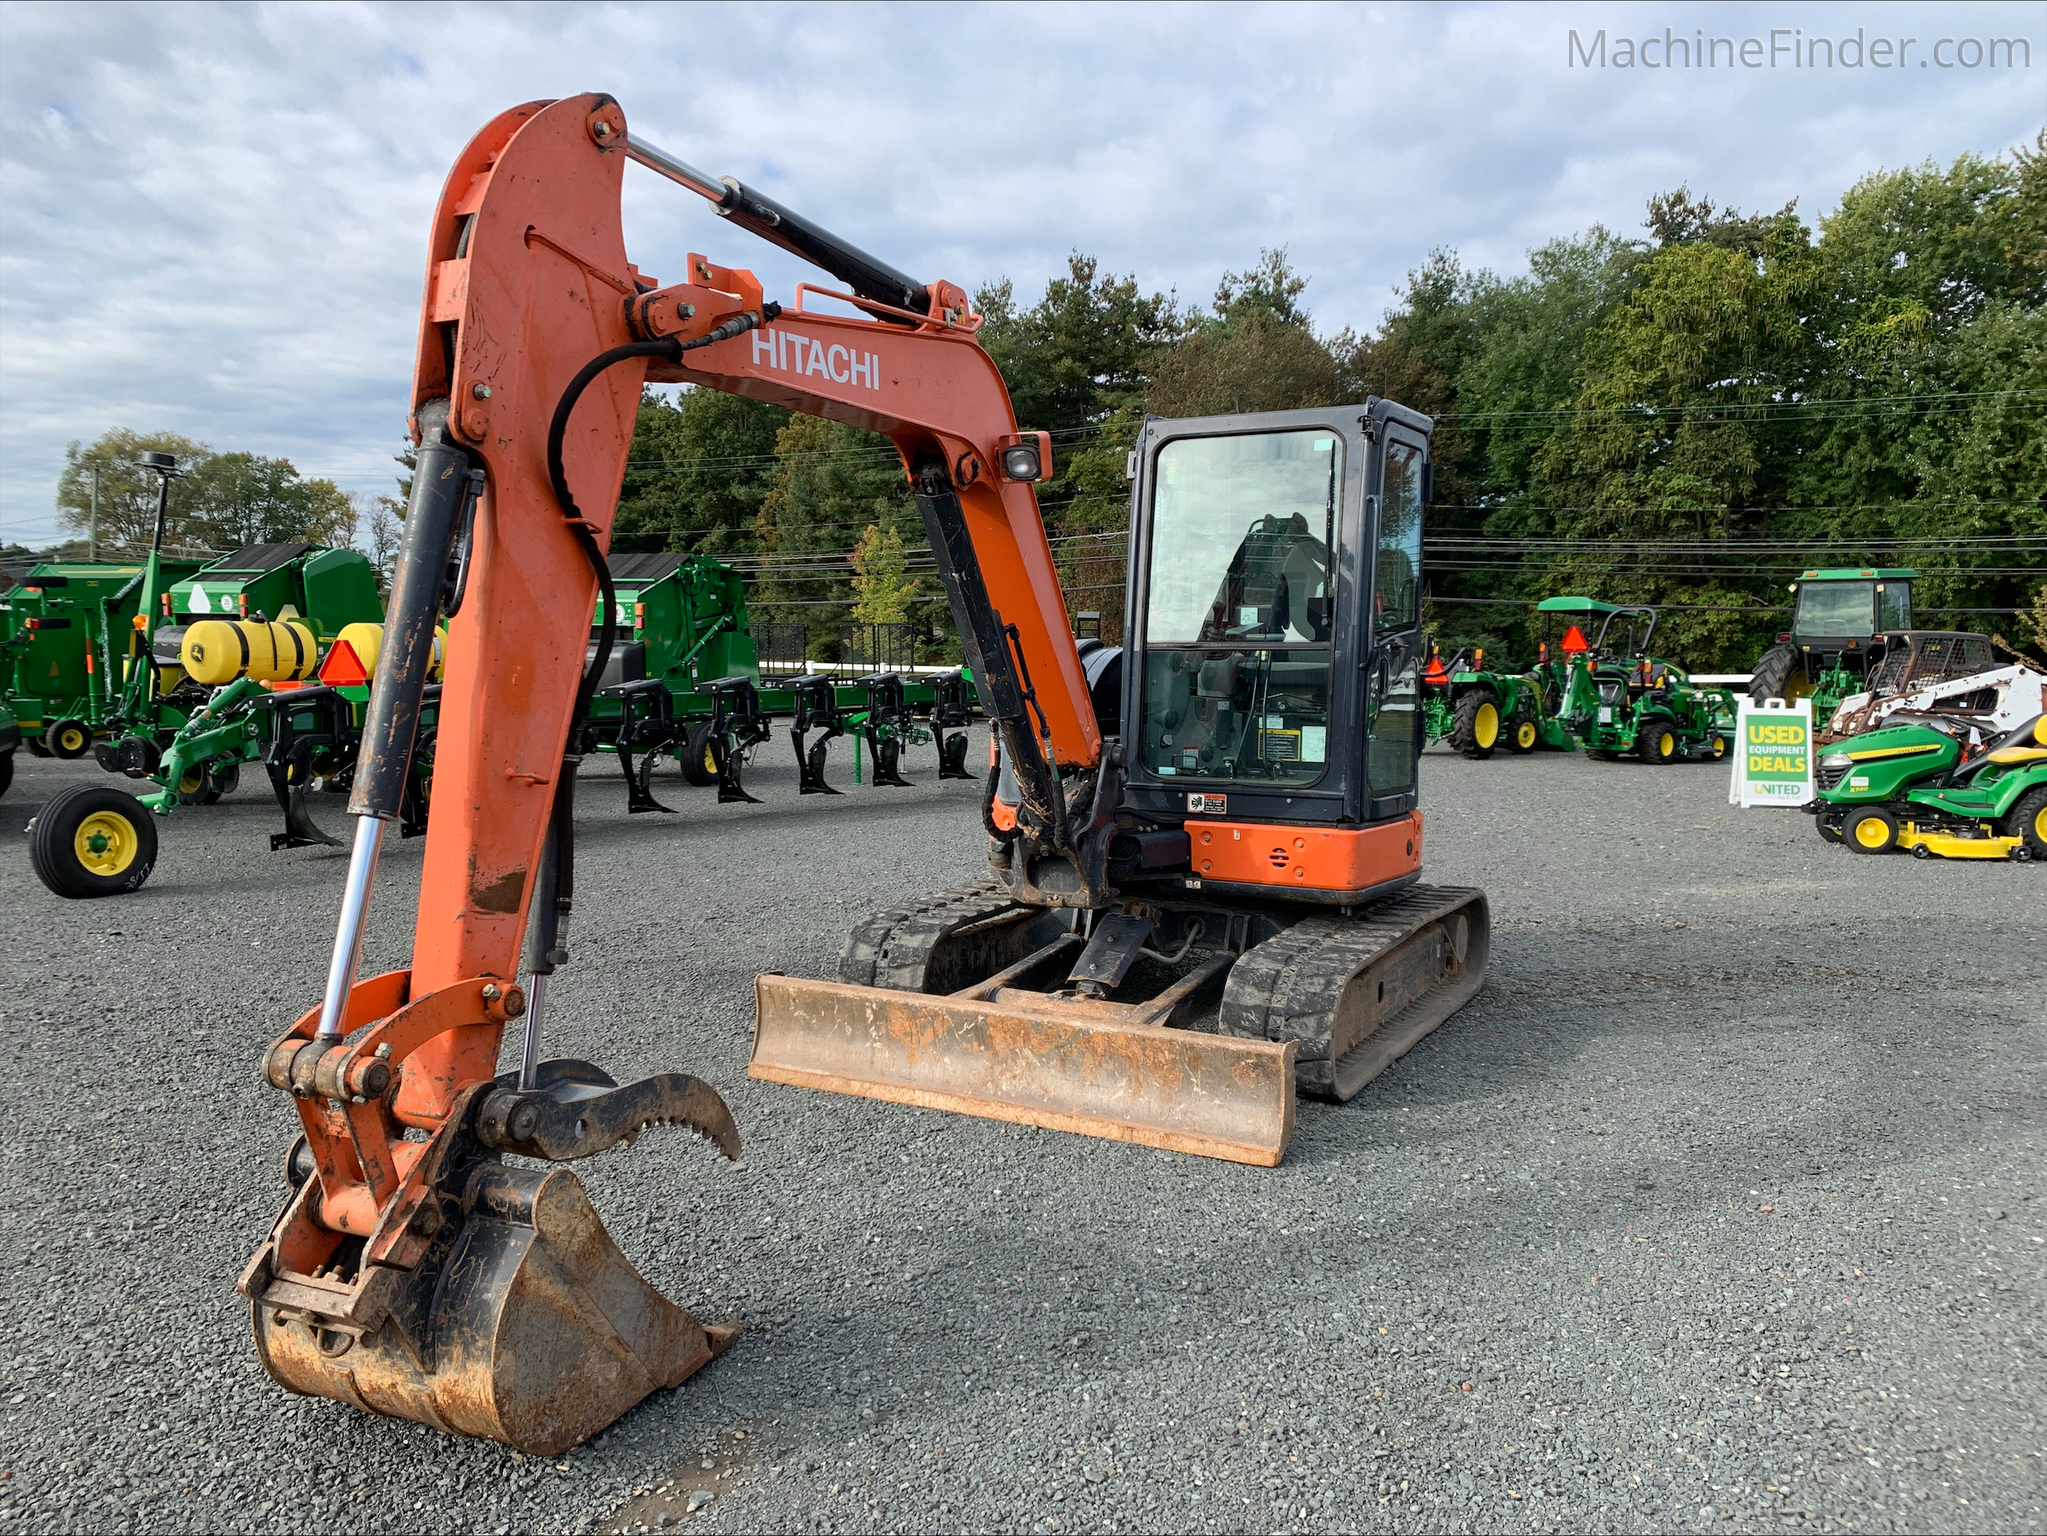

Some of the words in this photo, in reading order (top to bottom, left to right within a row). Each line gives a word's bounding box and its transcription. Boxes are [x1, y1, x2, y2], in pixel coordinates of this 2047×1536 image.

[752, 328, 880, 391] HITACHI
[1749, 725, 1805, 744] USED
[1748, 745, 1805, 755] EQUIPMENT
[1749, 756, 1806, 773] DEALS
[1753, 783, 1801, 795] UNITED
